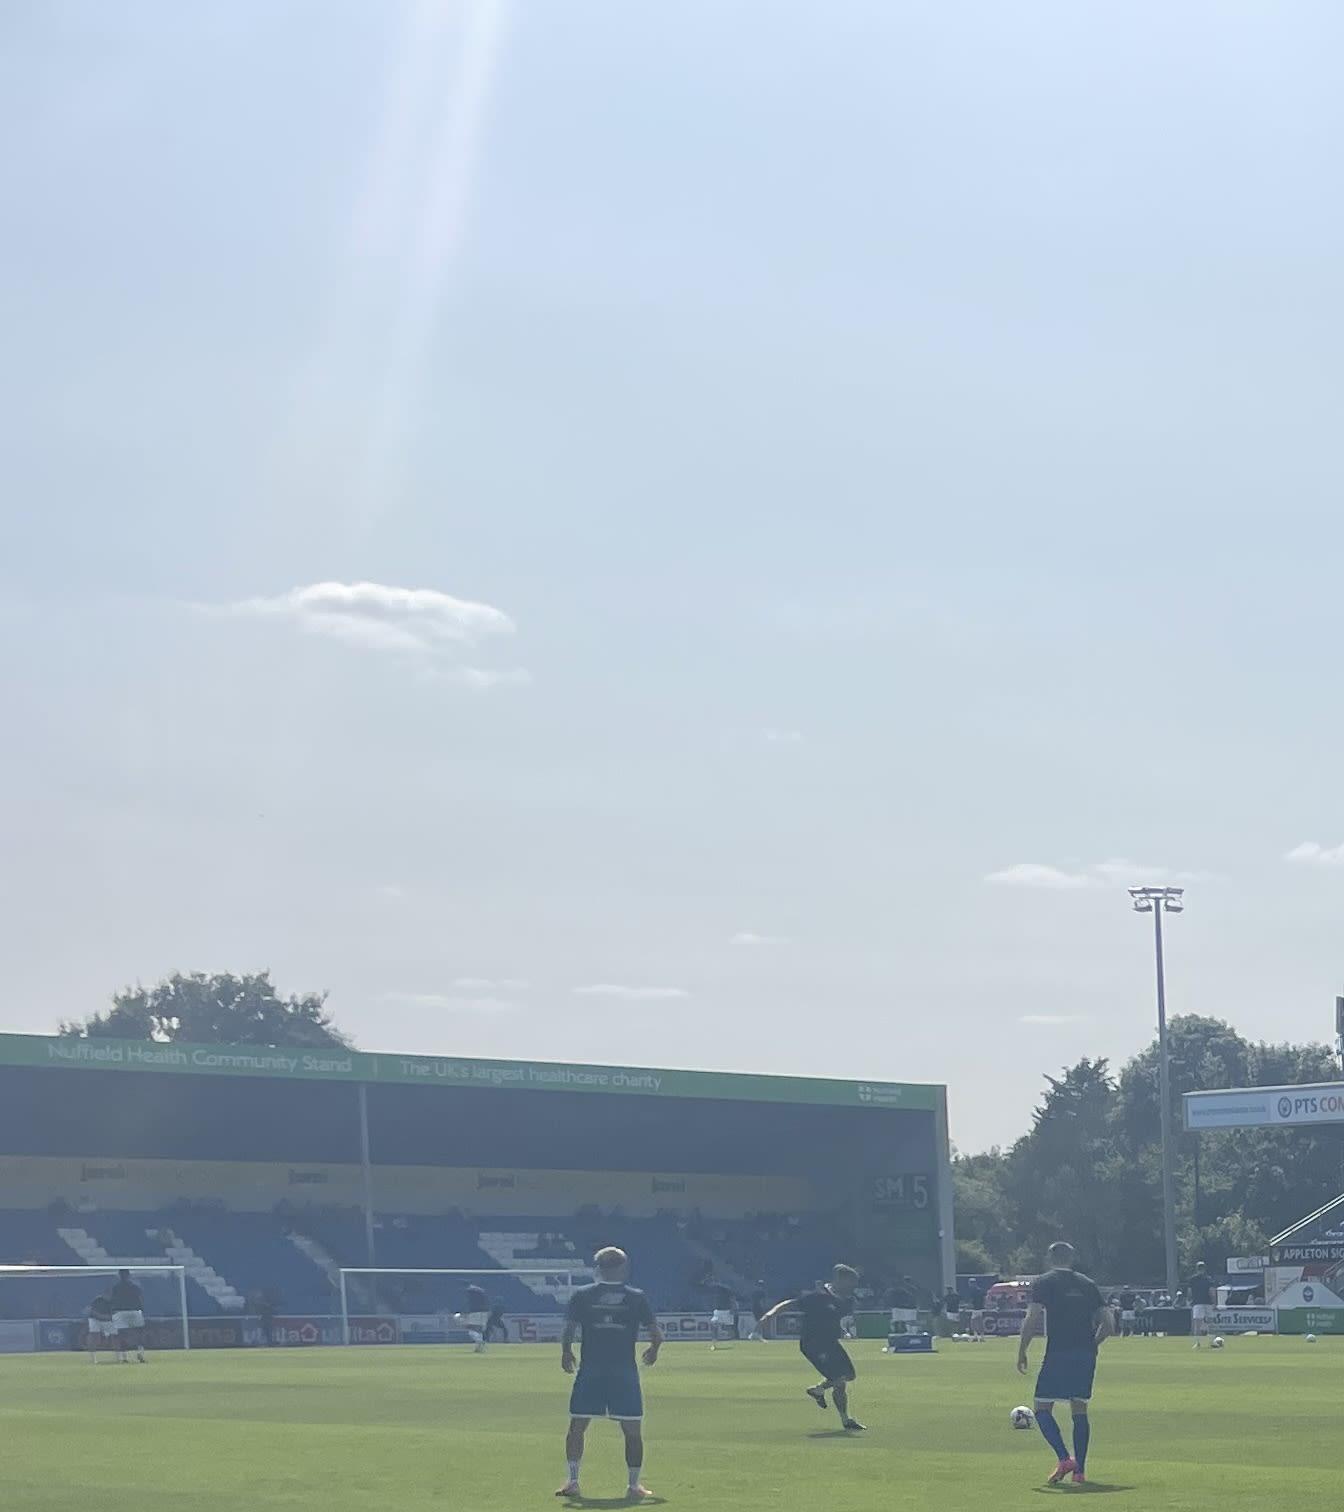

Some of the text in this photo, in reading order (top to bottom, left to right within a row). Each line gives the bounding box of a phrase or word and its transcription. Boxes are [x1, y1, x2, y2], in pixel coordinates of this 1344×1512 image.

[47, 1042, 353, 1073] Nuffield Health Community Stand
[400, 1059, 433, 1077] The
[528, 1065, 610, 1086] healthcare
[612, 1071, 662, 1092] charity
[1294, 1097, 1318, 1114] PTS
[1283, 1248, 1328, 1259] APPLETON
